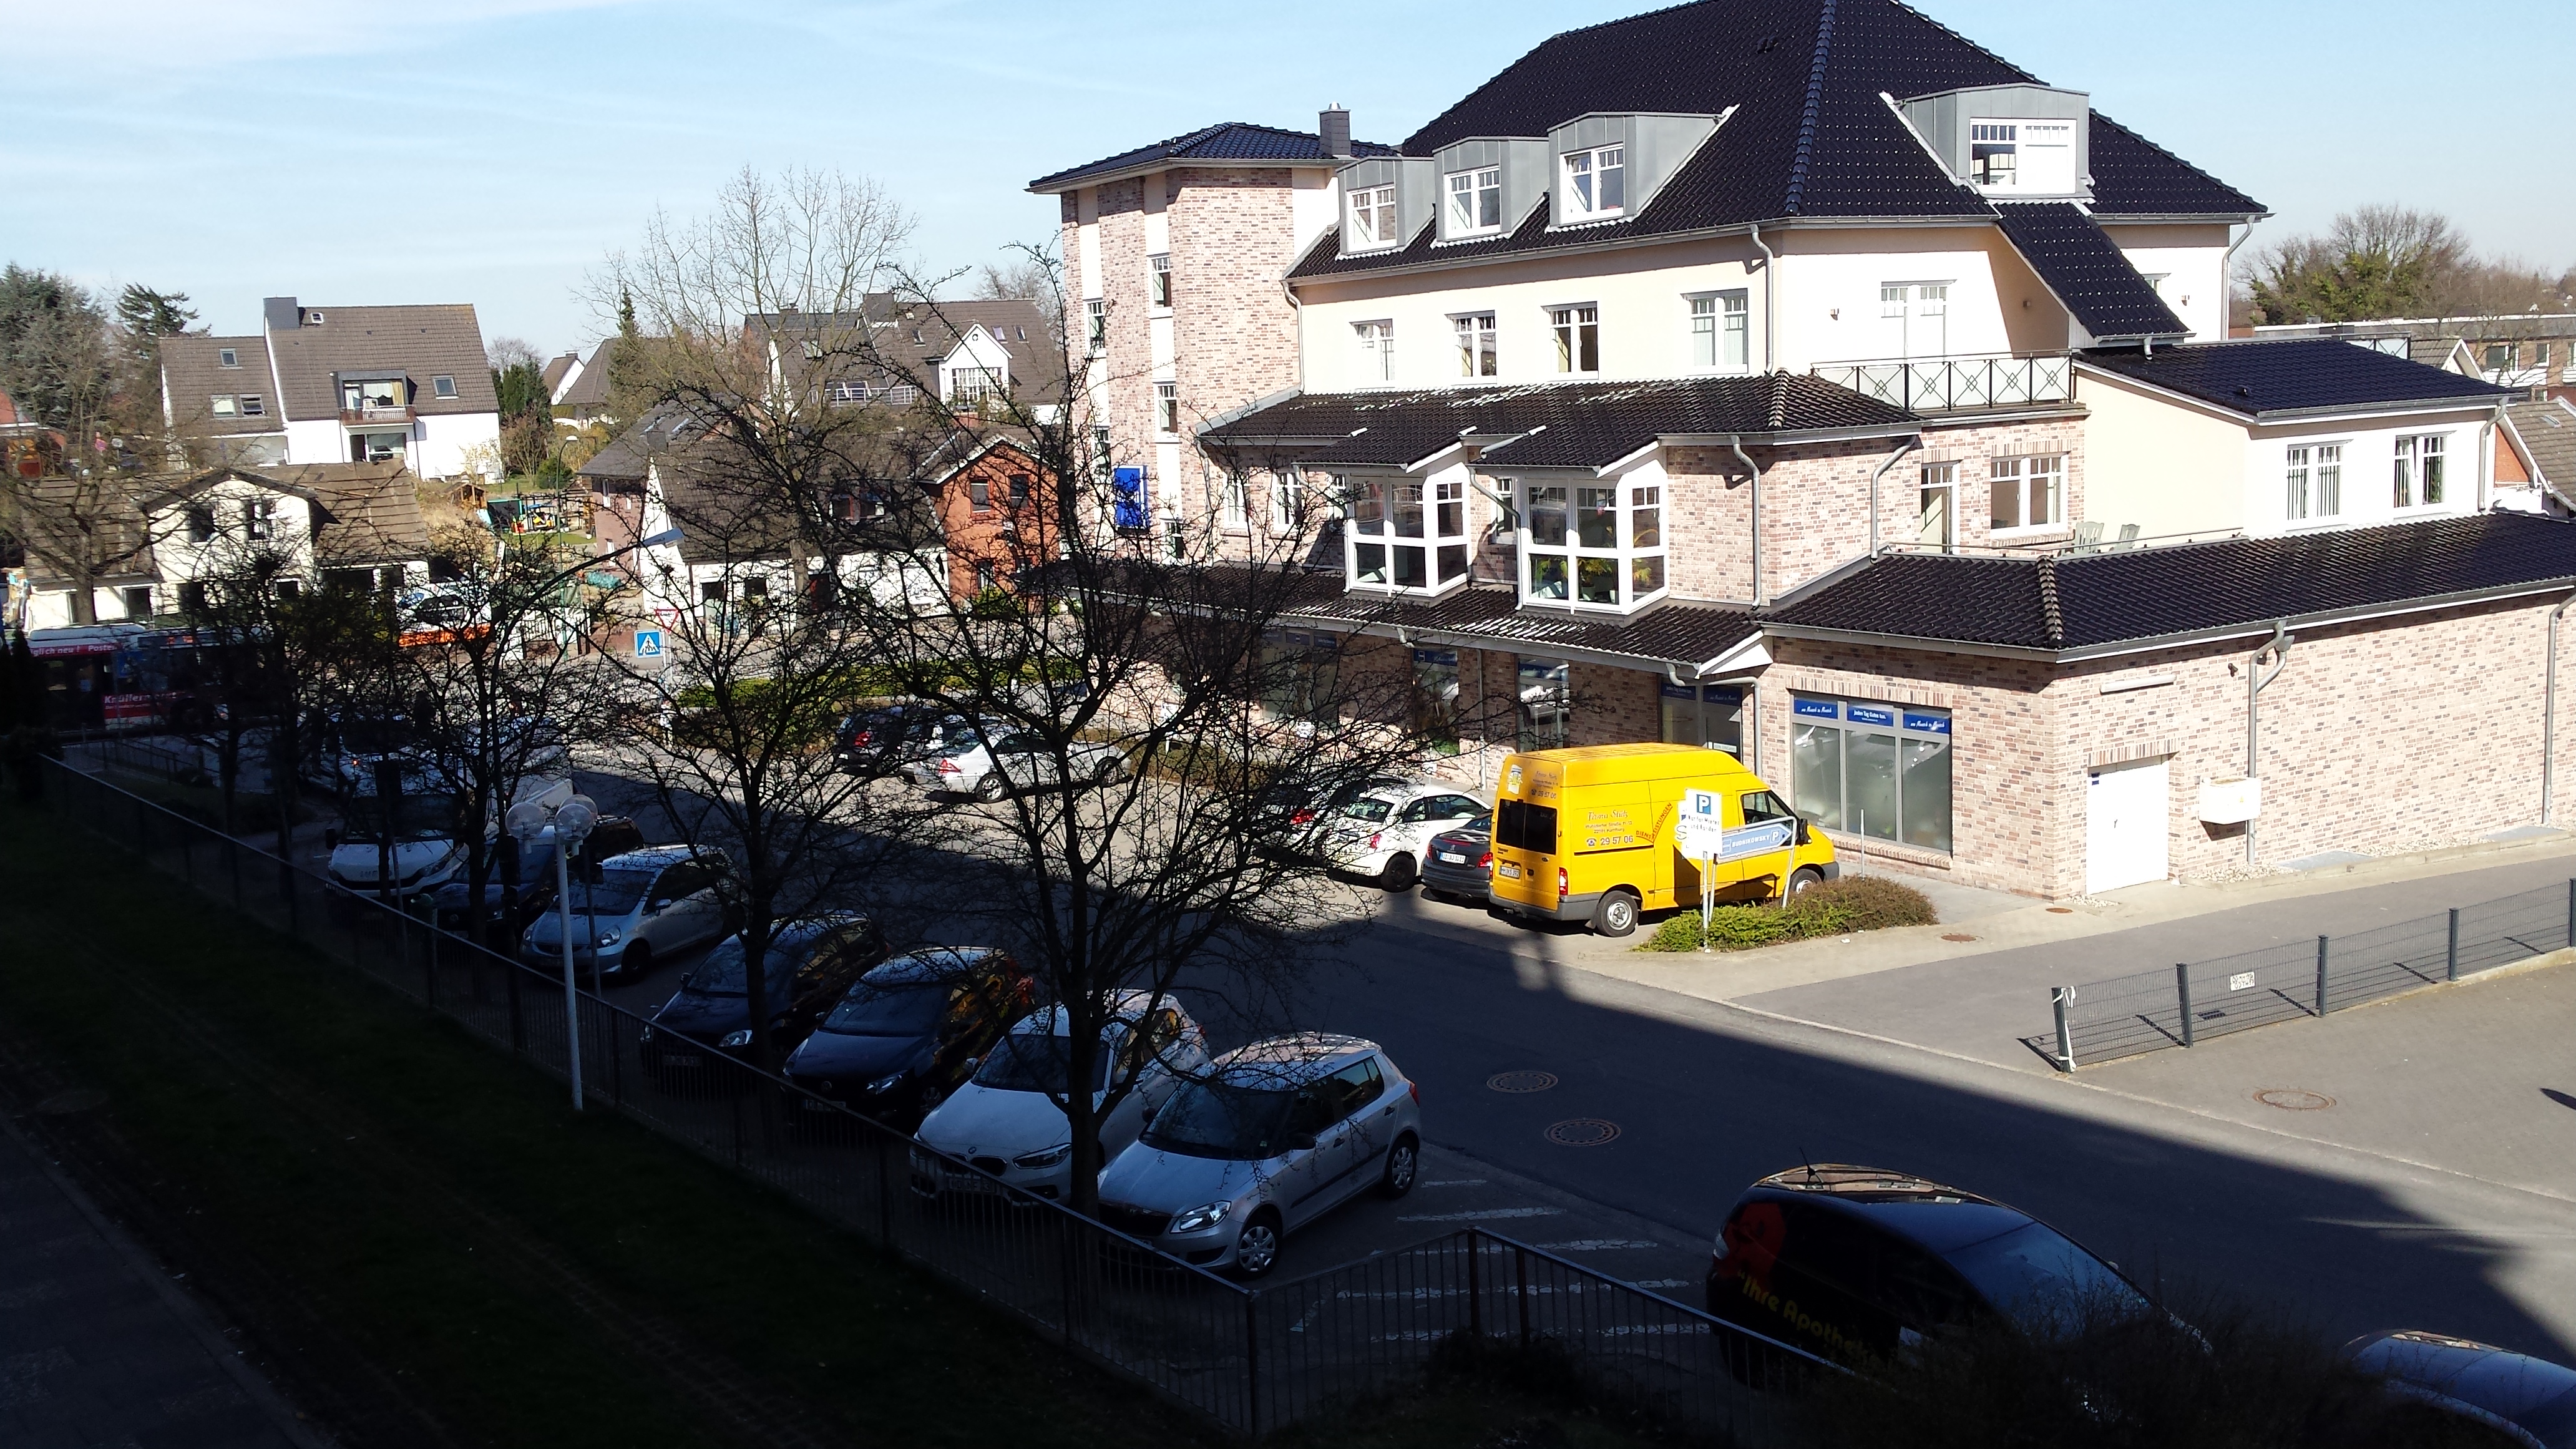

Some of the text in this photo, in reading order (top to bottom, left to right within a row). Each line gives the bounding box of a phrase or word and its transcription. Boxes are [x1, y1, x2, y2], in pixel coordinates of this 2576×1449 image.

[1699, 796, 1709, 813] P
[1600, 835, 1634, 846] 29 57 06
[1731, 831, 1779, 848] BUDNIKOWSKY P
